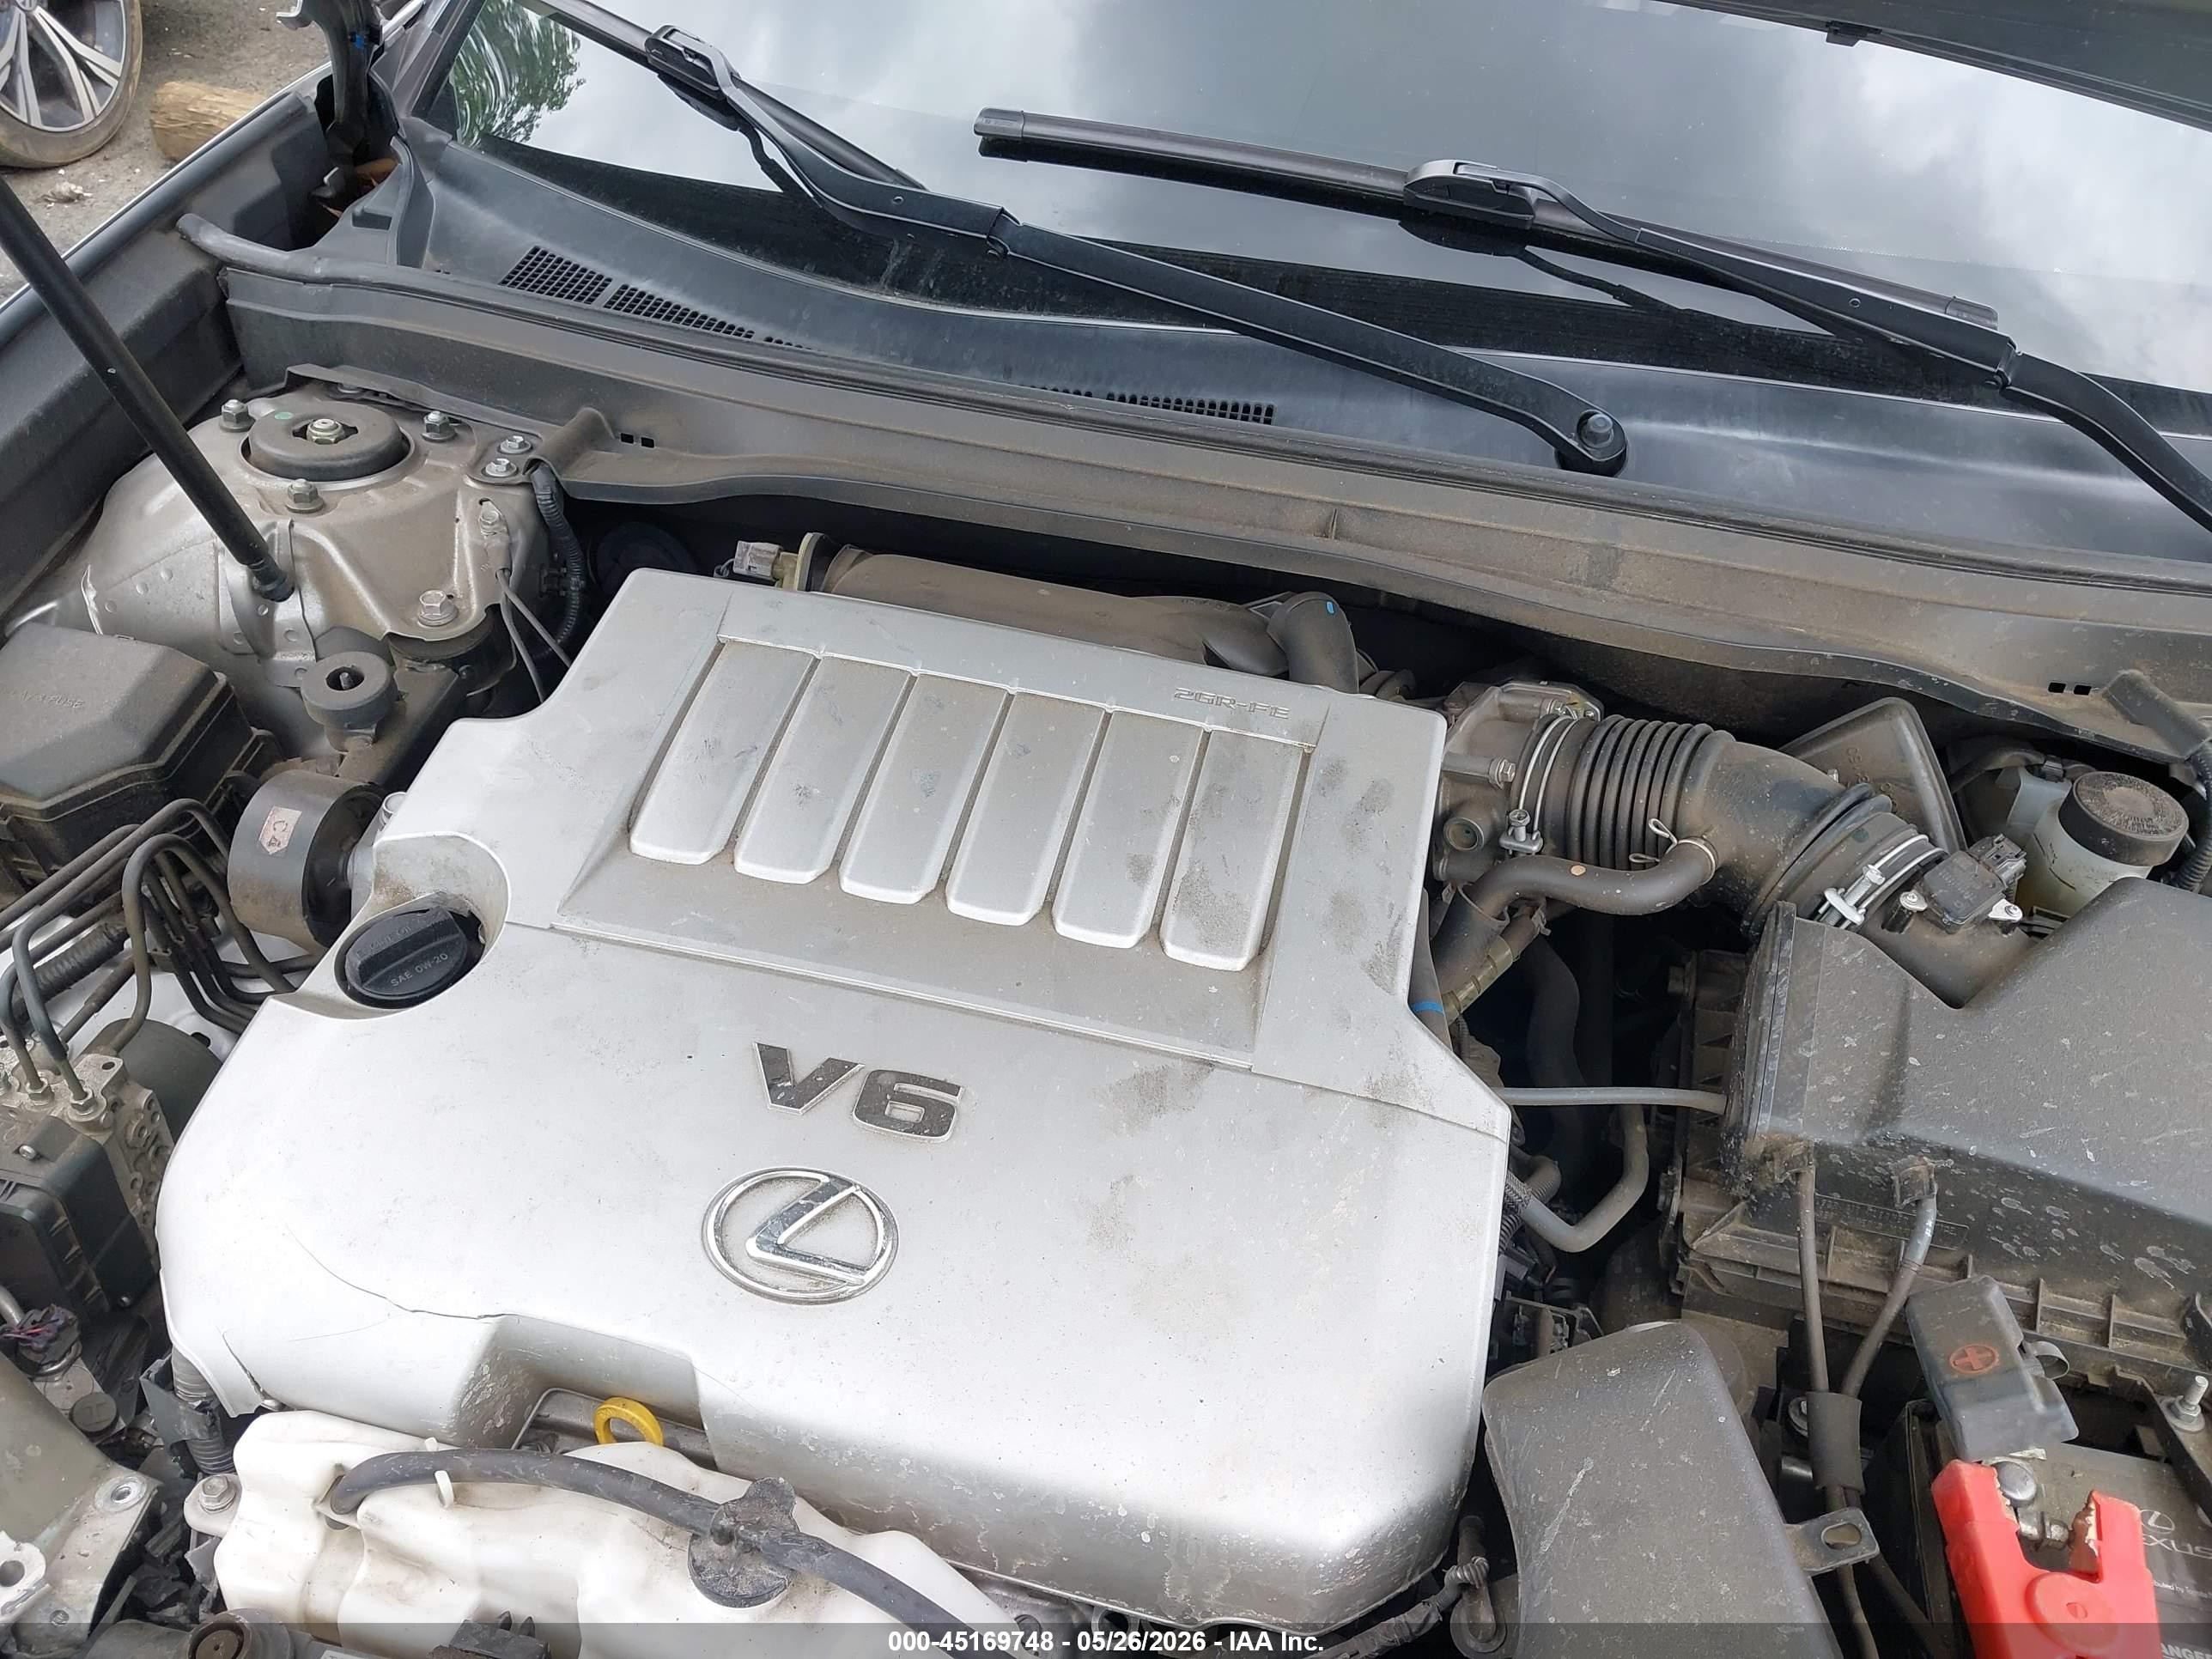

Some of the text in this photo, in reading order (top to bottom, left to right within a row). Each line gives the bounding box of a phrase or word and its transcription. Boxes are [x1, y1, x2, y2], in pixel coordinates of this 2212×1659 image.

[1174, 687, 1291, 720] 2GR-FE
[390, 952, 448, 987] SAE 0W-20
[752, 1042, 965, 1143] V6
[2142, 1534, 2212, 1559] EXUS
